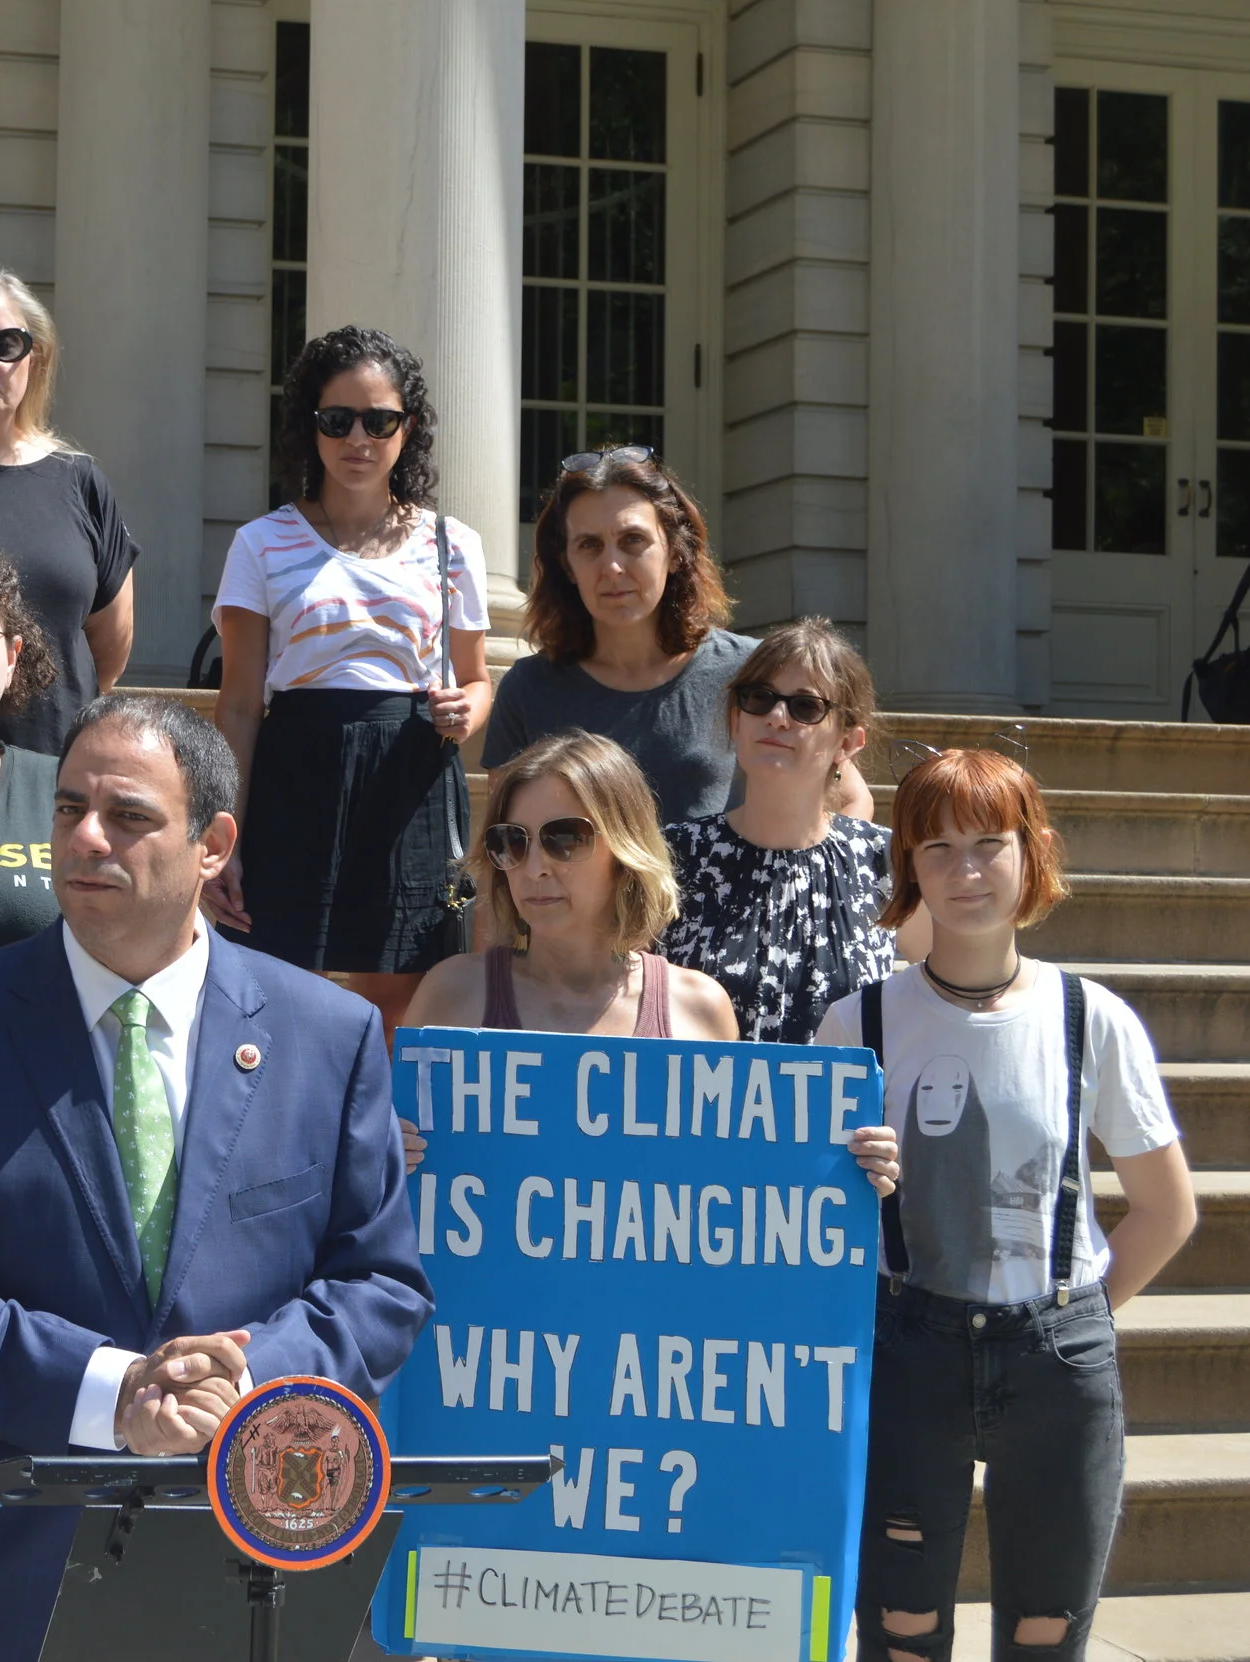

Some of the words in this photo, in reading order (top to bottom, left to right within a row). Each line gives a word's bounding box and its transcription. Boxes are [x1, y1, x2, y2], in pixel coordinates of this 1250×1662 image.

[400, 1045, 543, 1136] THE
[576, 1050, 868, 1145] CLIMATE
[418, 1172, 487, 1258] IS
[514, 1175, 866, 1268] CHANGING.
[433, 1323, 581, 1418] WHY
[609, 1332, 858, 1433] AREN'T
[284, 1518, 314, 1530] 1625
[549, 1443, 698, 1534] WE?
[433, 1559, 772, 1630] #CLIMATEDEBATE
